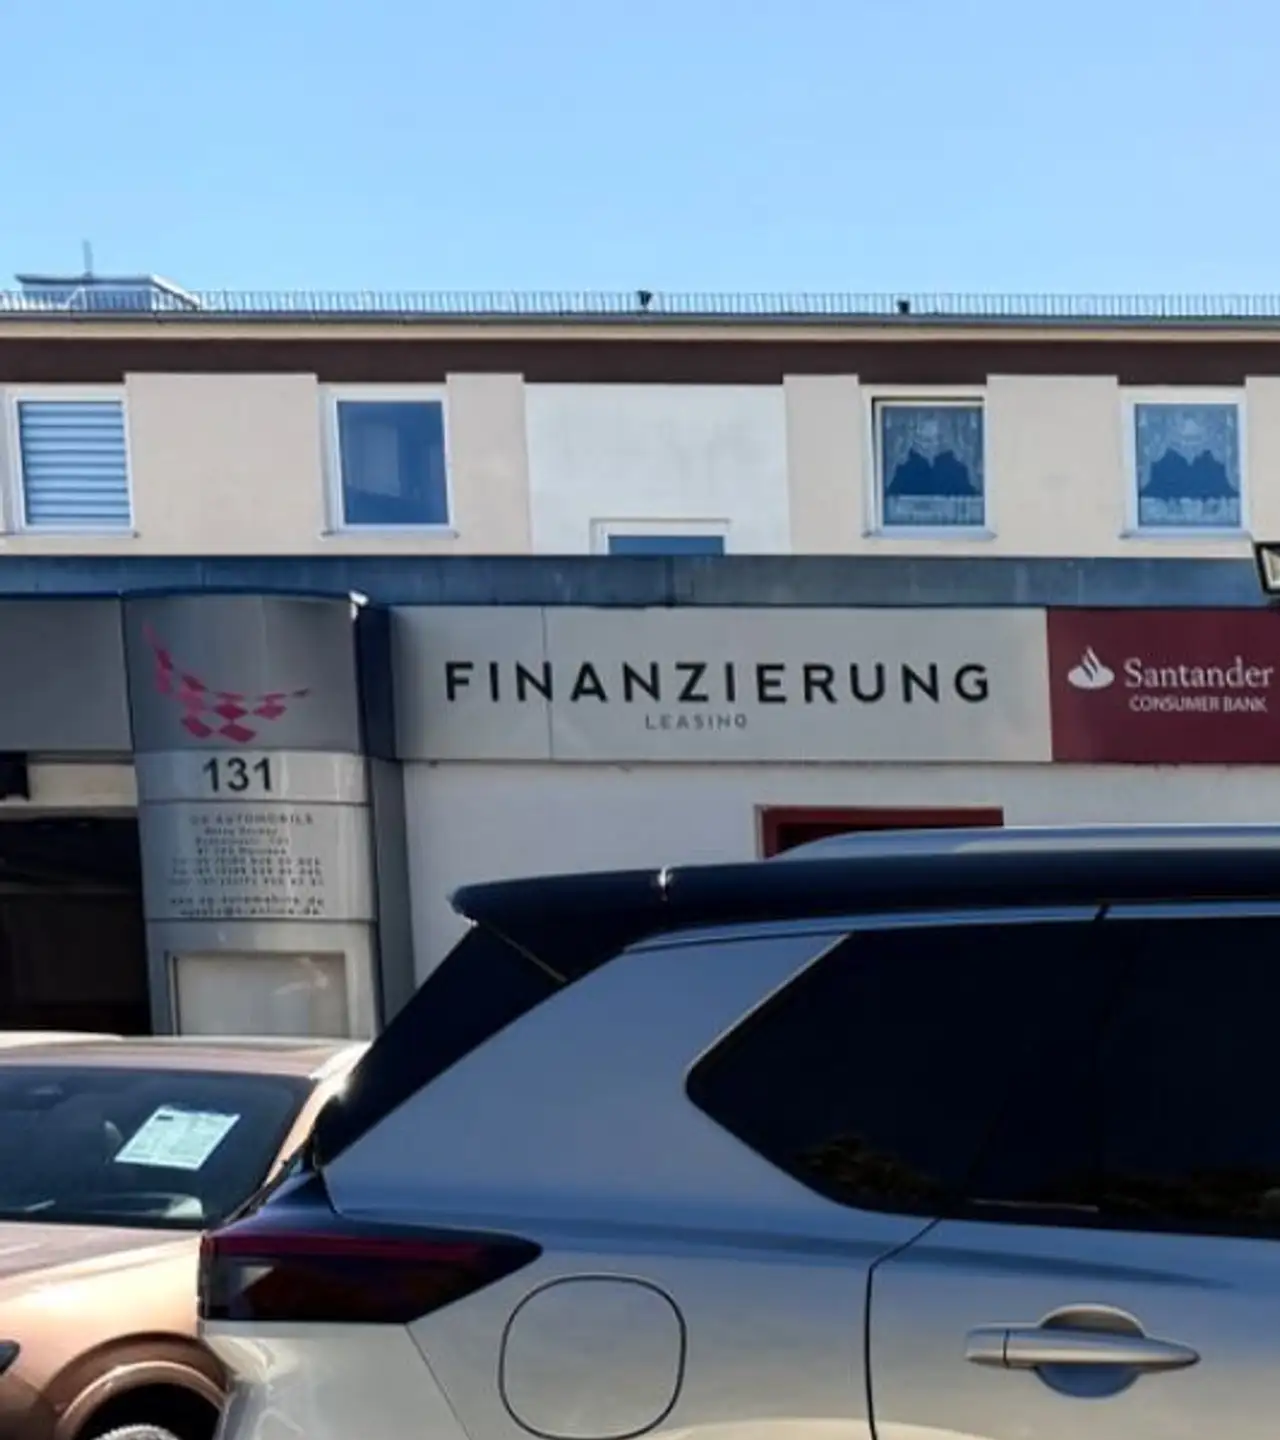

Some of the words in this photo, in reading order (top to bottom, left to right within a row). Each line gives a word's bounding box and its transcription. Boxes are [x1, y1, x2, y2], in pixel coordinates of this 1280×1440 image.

[444, 660, 991, 704] FINANZIERUNG
[1123, 655, 1275, 689] Santander
[1128, 694, 1221, 713] CONSUMER
[1223, 695, 1269, 713] BANK
[645, 713, 748, 731] LEASING
[203, 756, 273, 793] 131
